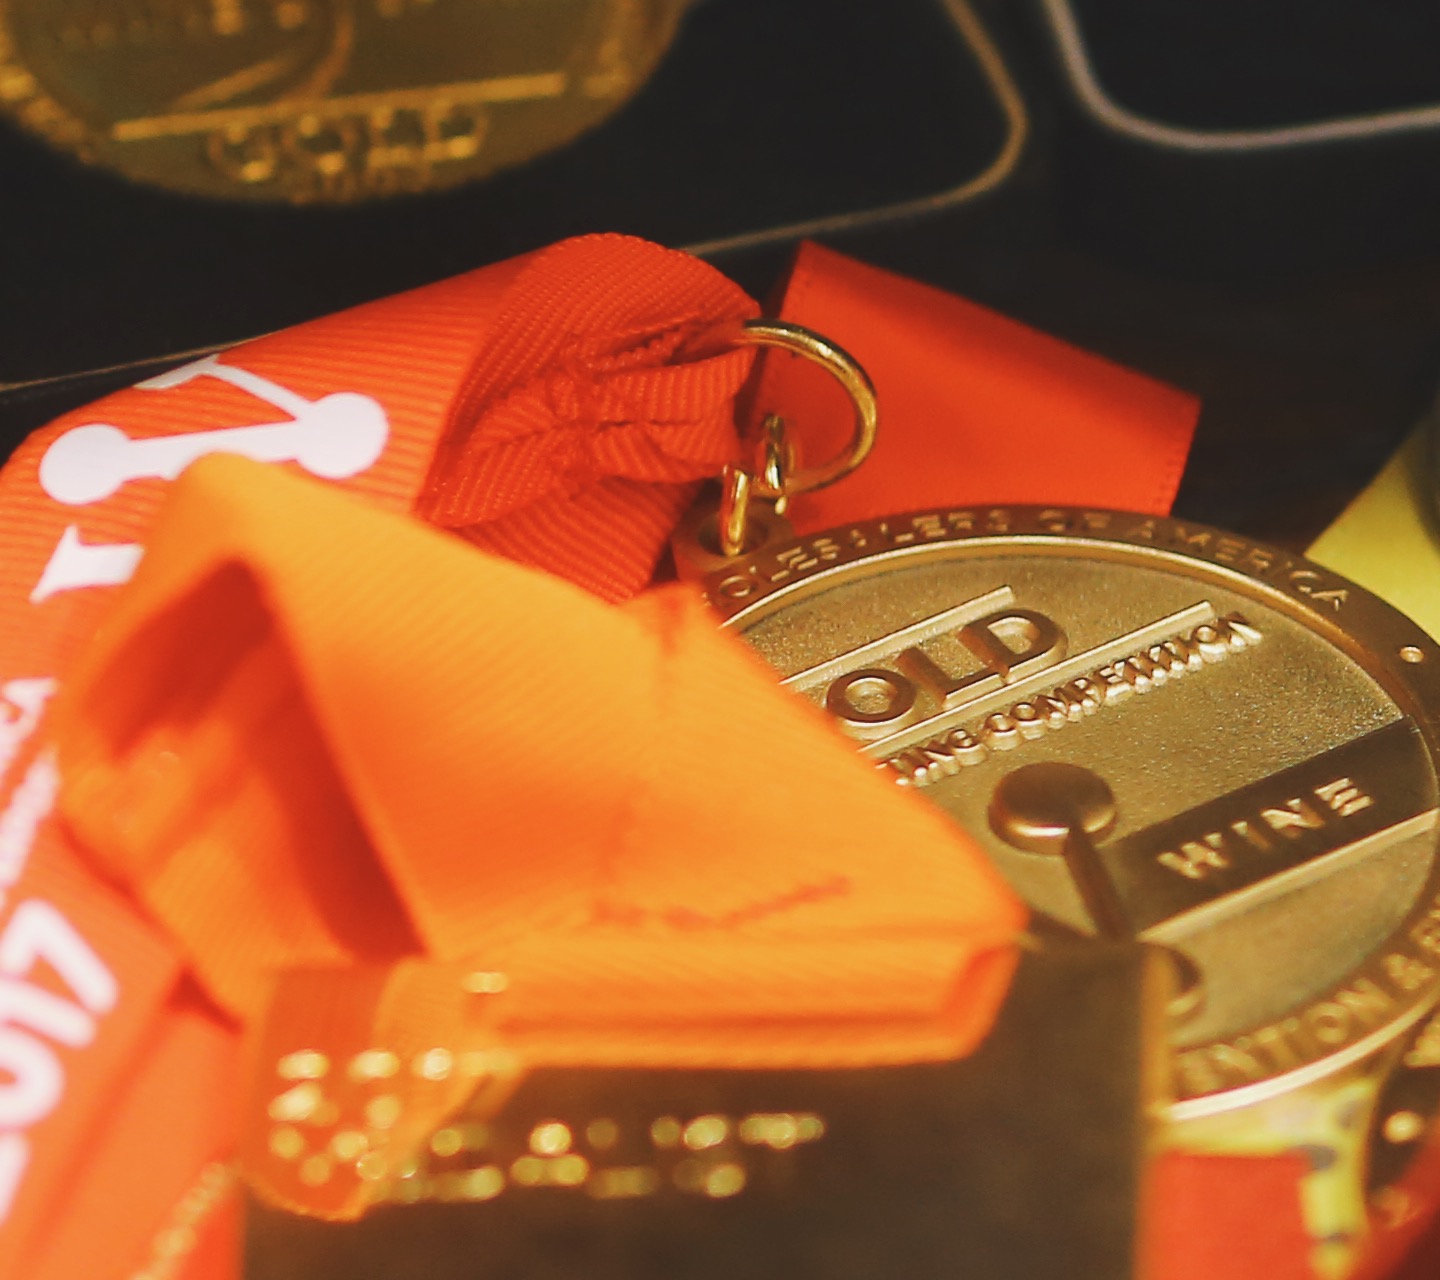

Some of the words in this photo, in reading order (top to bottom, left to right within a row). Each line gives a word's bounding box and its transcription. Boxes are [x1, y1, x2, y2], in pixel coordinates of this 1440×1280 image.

[705, 510, 1010, 602] OLESALERS
[1135, 518, 1350, 612] AMERICA
[822, 608, 1070, 732] OLD
[980, 610, 1264, 754] COMPETITION
[1156, 774, 1376, 884] WINE
[0, 898, 120, 1220] 017
